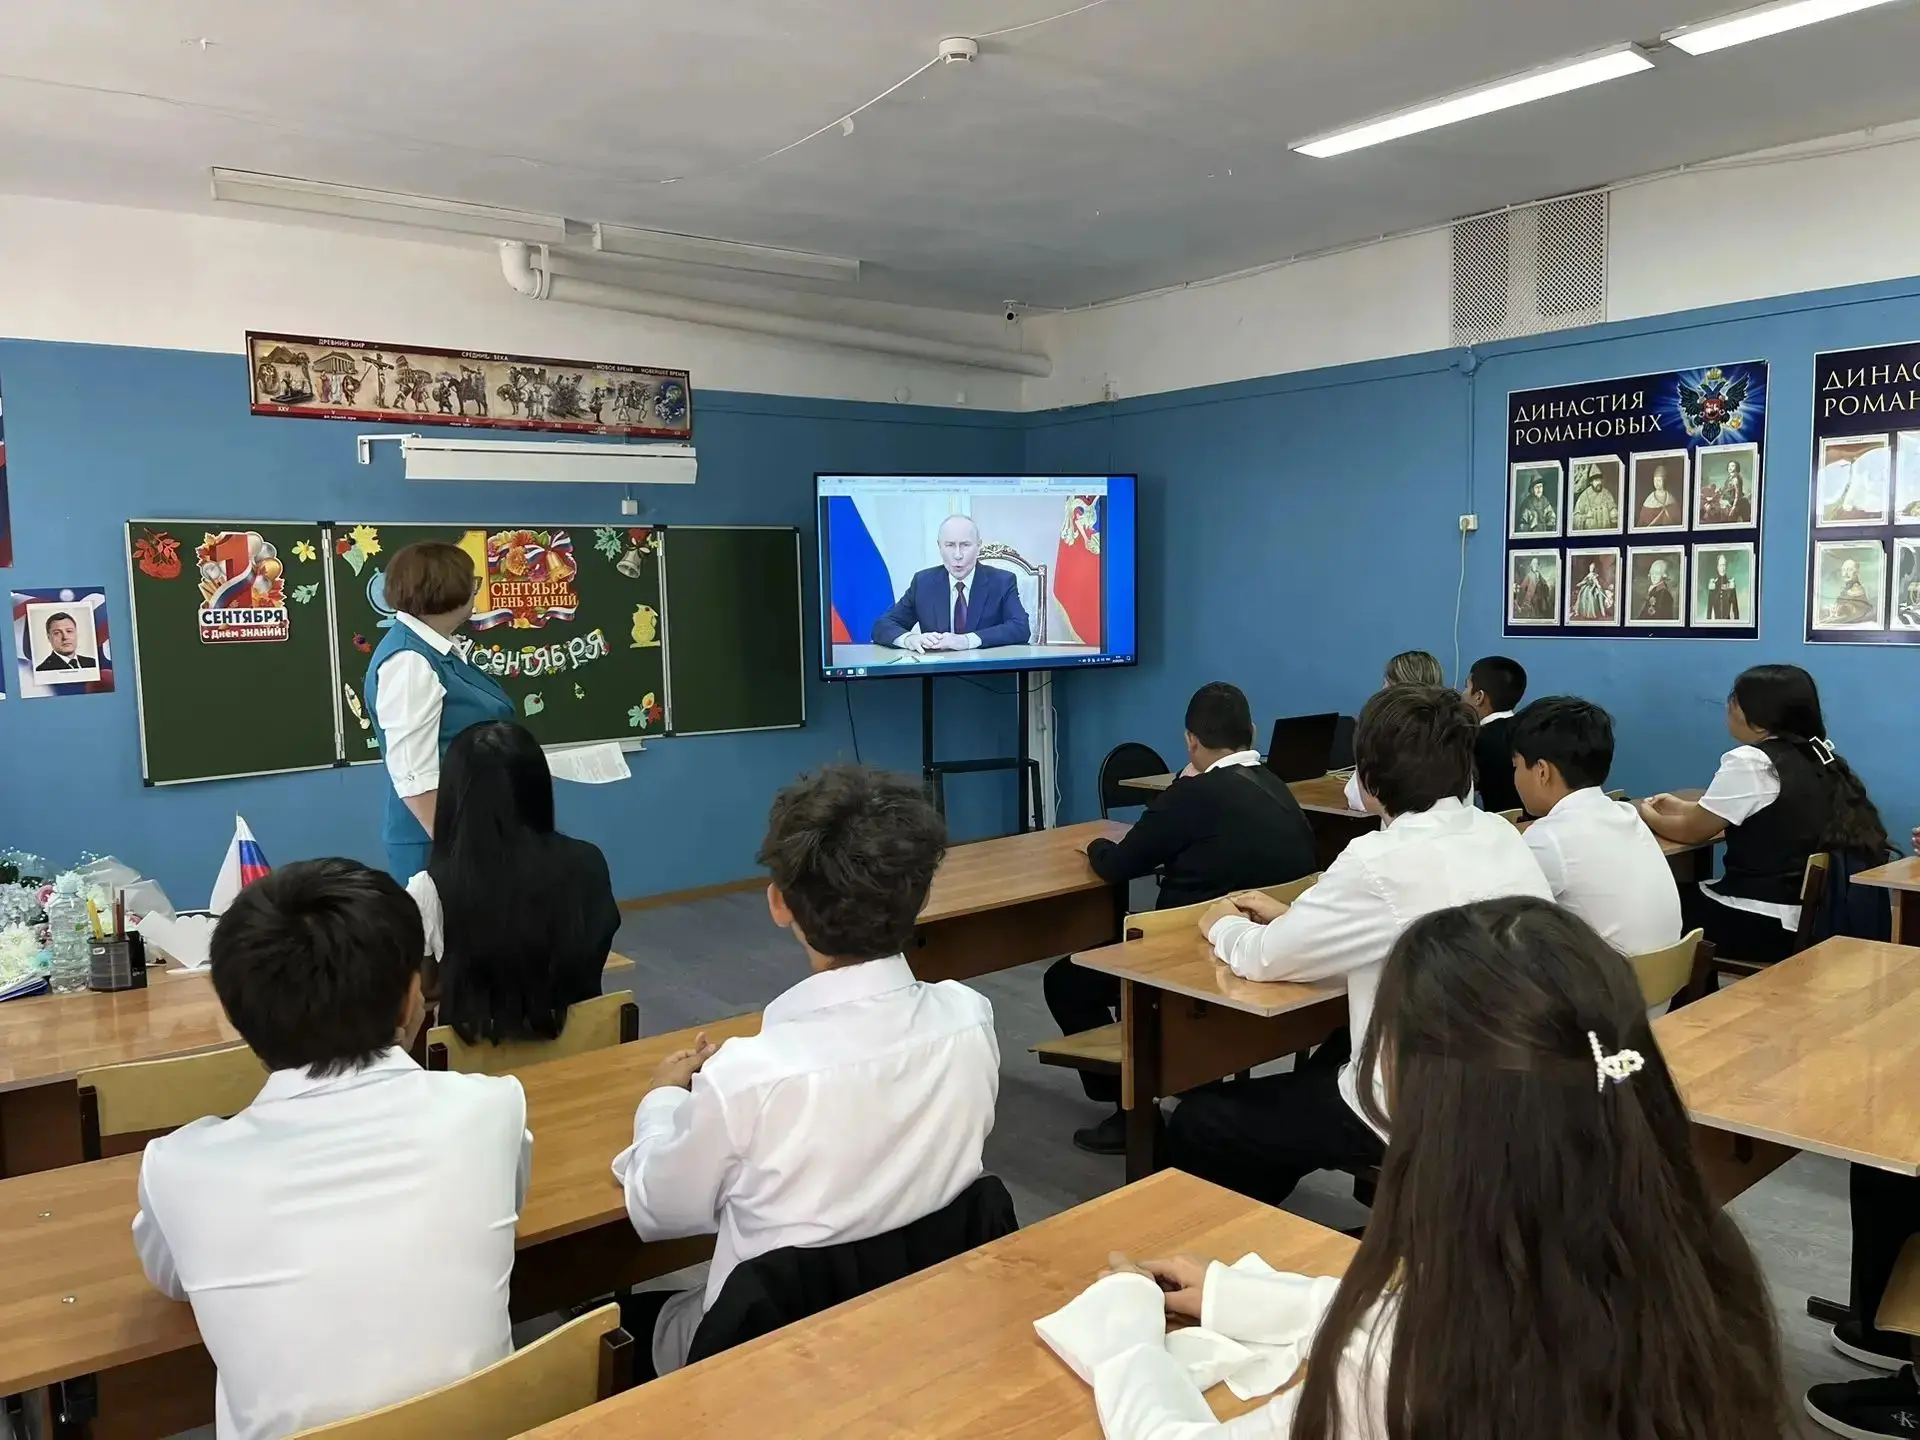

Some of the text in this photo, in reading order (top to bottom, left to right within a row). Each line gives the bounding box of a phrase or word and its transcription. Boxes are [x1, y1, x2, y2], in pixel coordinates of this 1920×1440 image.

[318, 338, 366, 349] ДРЕВНИЙ МИР
[1513, 390, 1645, 424] ДИНАСТИЯ
[1514, 413, 1663, 446] РОМАНОВЫХ
[491, 592, 577, 610] ДЕНЬ ЗНАНИЙ
[201, 609, 283, 625] СЕНТЯБРЯ
[240, 627, 286, 637] ЗНАНИЙ!
